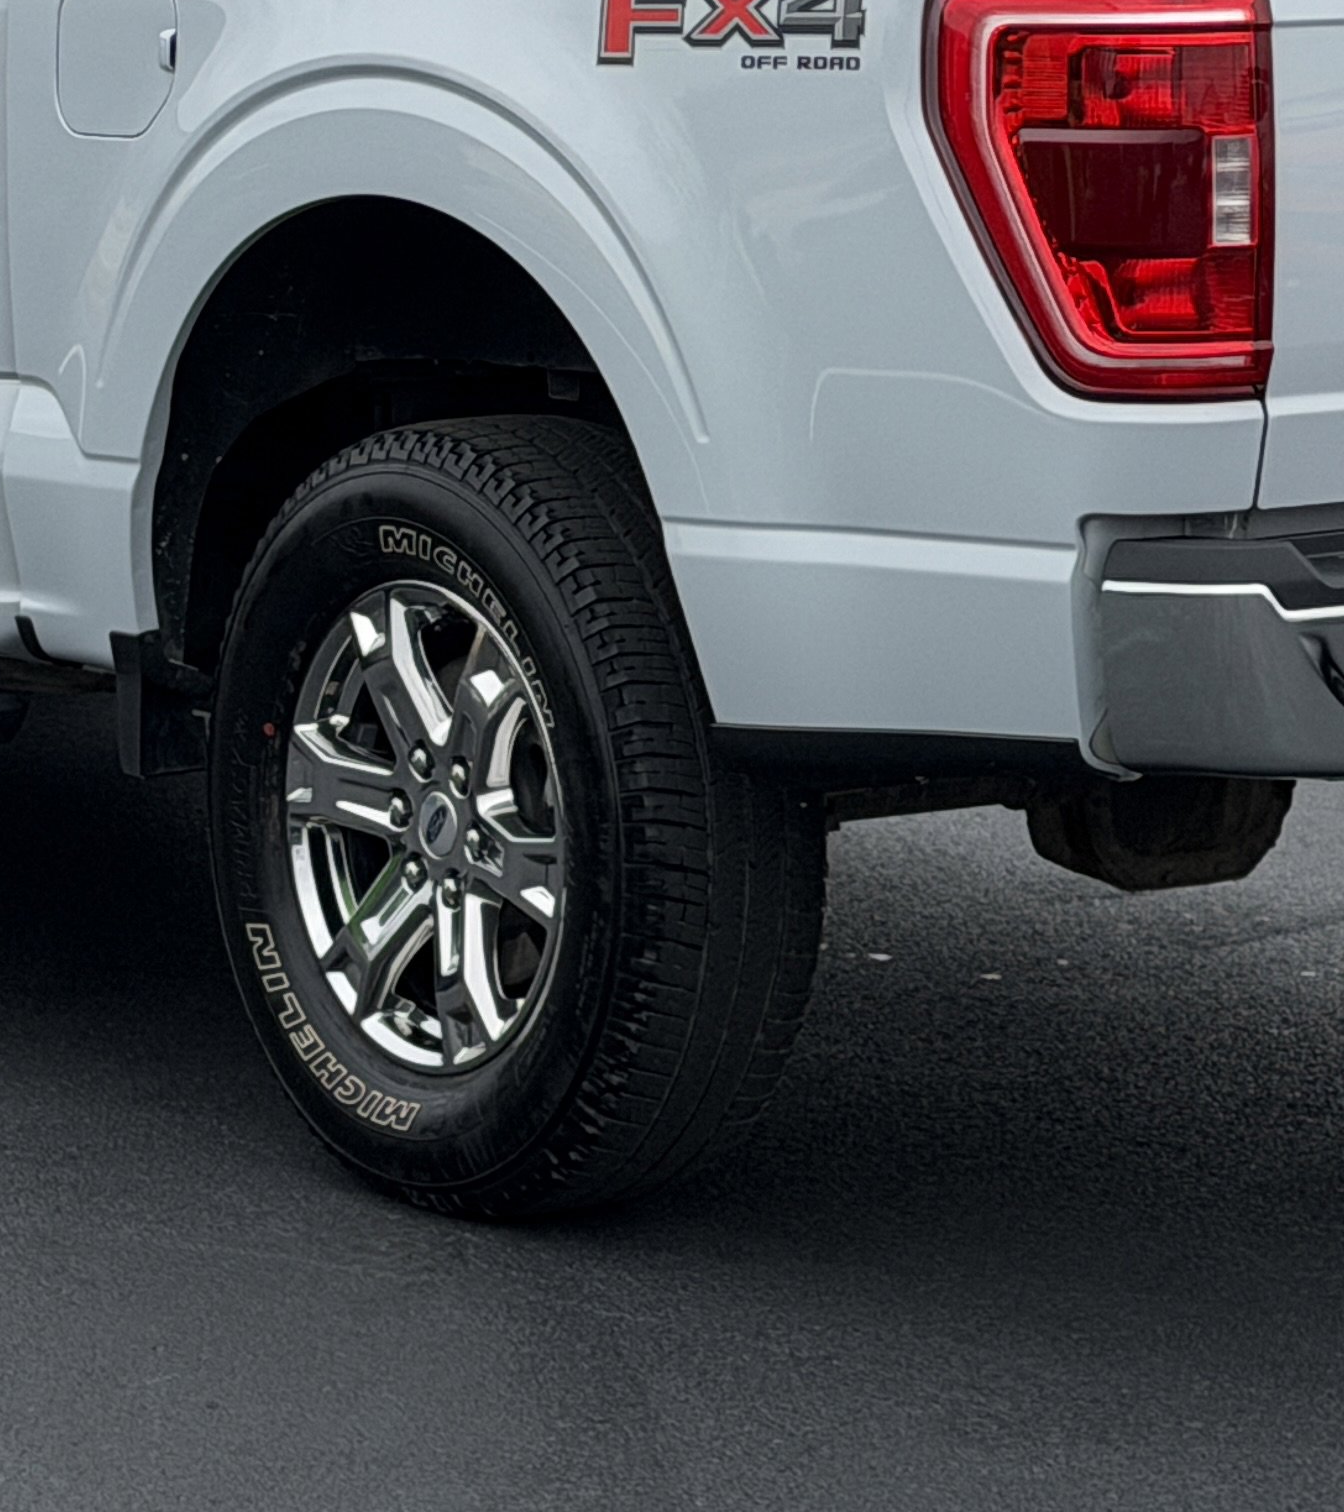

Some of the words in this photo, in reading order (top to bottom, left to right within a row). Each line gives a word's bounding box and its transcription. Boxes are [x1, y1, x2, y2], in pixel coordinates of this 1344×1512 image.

[740, 54, 788, 70] OFF
[796, 55, 861, 71] ROAD
[378, 524, 556, 731] MICHELIN
[246, 923, 421, 1131] MICHELIN
